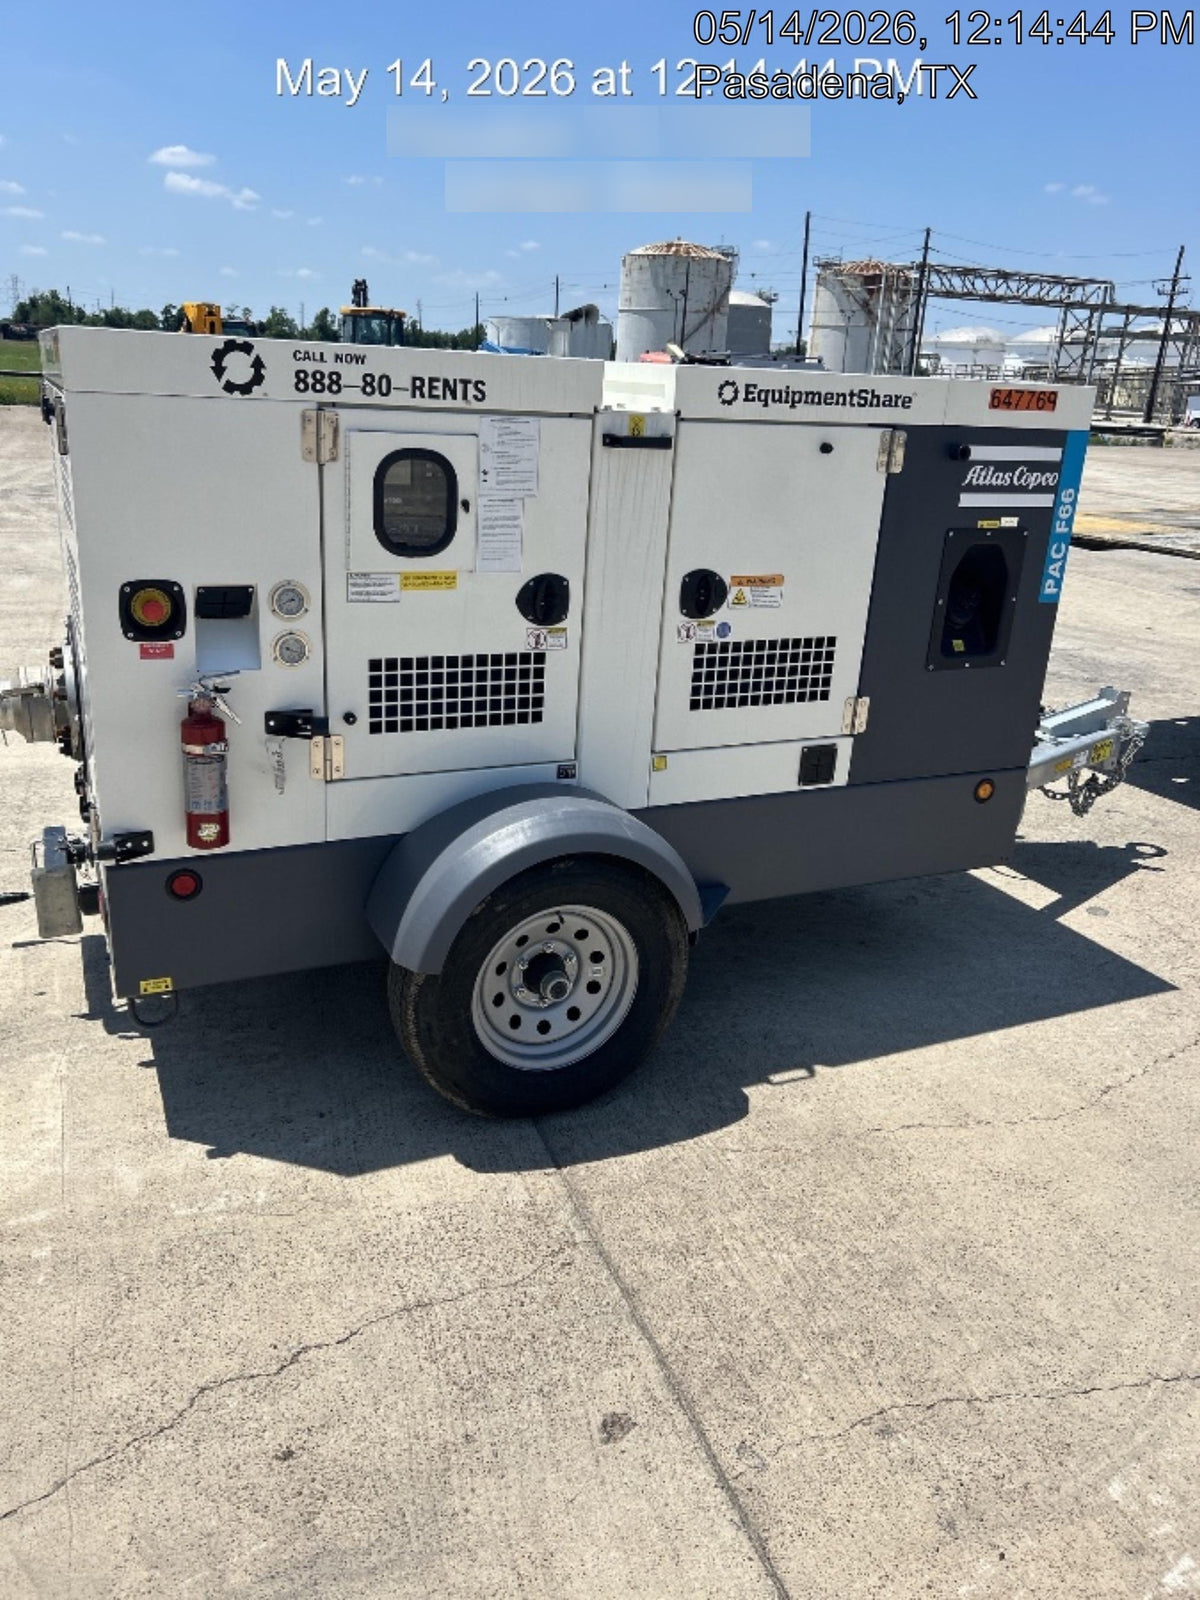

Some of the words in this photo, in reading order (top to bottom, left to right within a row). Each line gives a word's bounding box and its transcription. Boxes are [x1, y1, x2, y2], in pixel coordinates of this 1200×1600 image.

[293, 350, 327, 363] CALL
[334, 353, 366, 365] NOW
[294, 370, 486, 402] 888-80-RENTS
[743, 383, 913, 410] EquipmentShare
[991, 389, 1058, 411] 647769
[961, 465, 1012, 486] Atlas
[1013, 466, 1058, 490] Copco
[1044, 542, 1066, 595] PAC
[1055, 488, 1075, 534] F66
